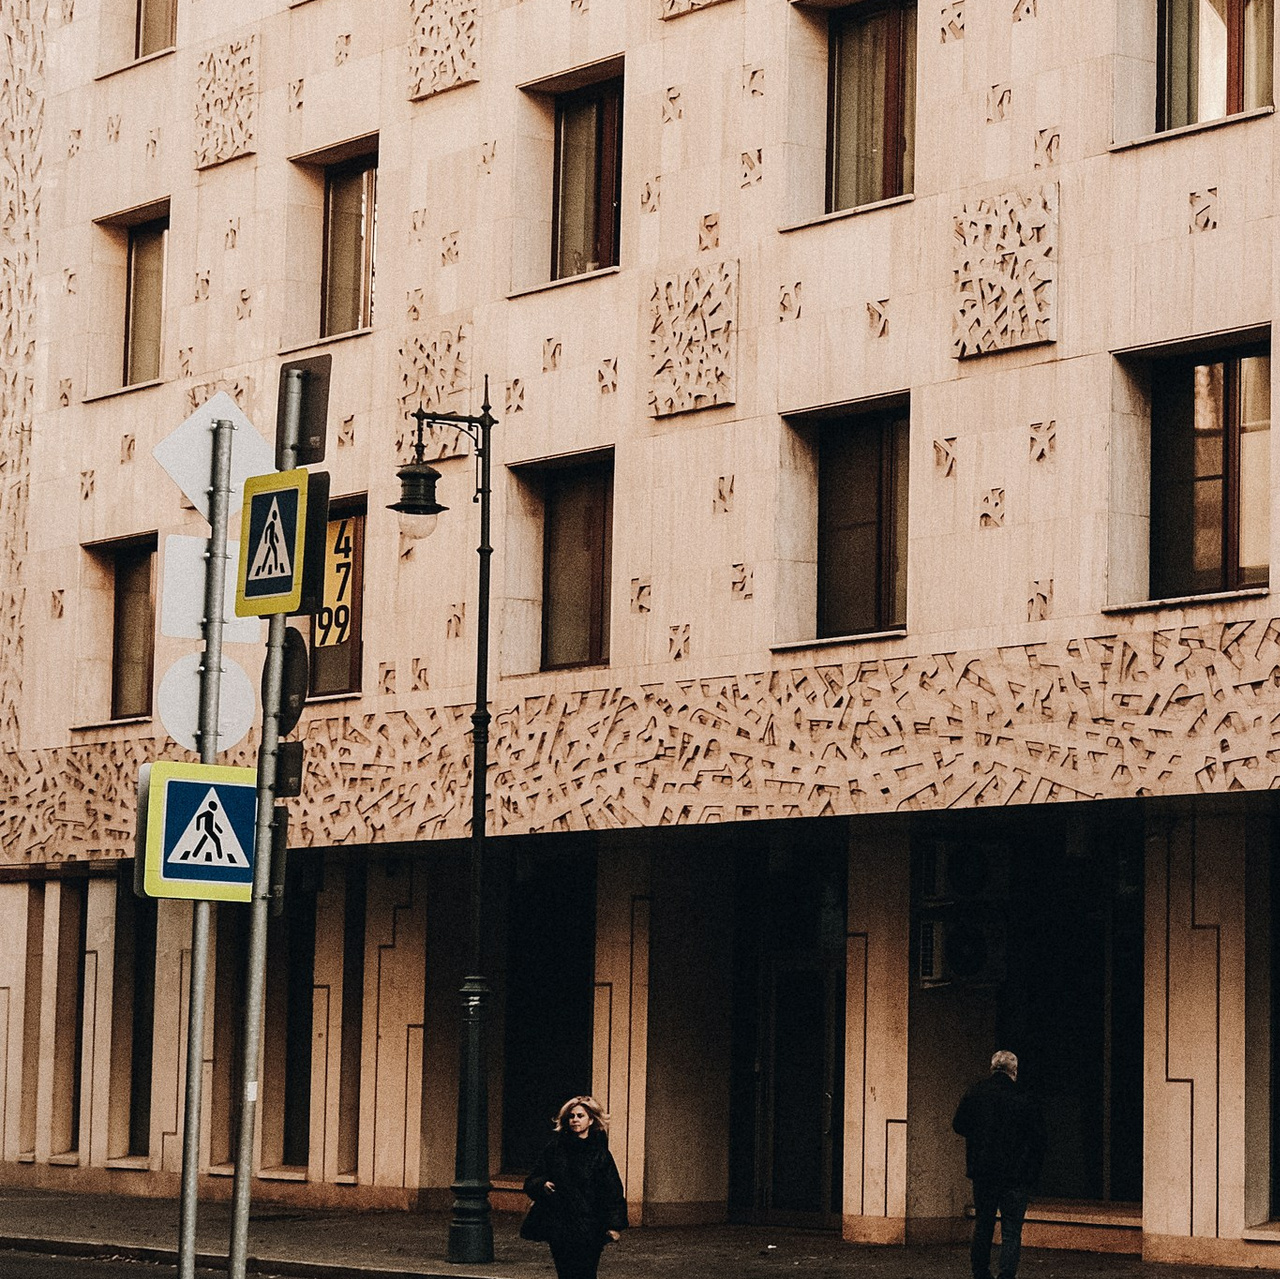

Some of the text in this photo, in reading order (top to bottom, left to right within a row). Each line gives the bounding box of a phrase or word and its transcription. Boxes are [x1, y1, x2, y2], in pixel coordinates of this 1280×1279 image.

[334, 520, 352, 559] 4
[336, 562, 351, 602] 7
[318, 605, 350, 646] 99
